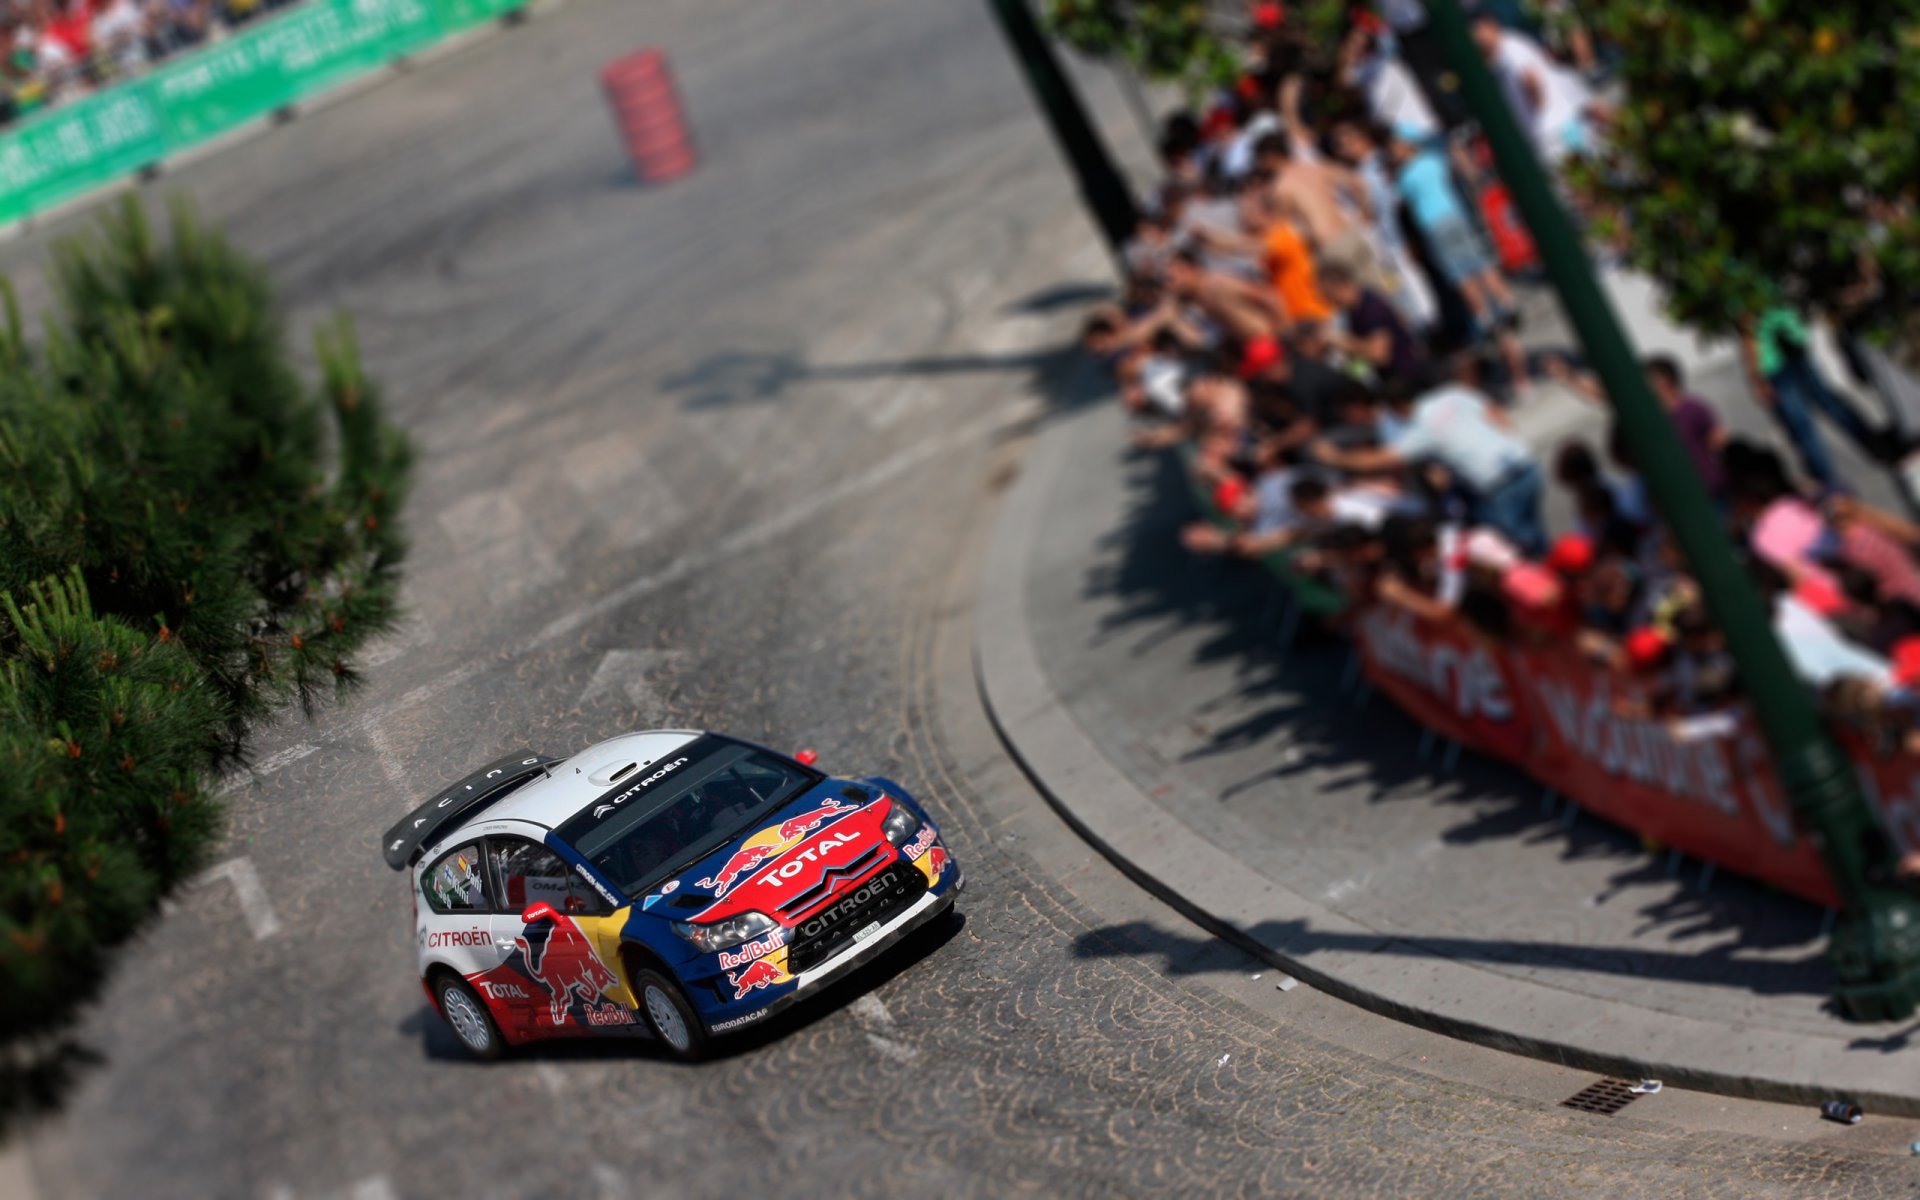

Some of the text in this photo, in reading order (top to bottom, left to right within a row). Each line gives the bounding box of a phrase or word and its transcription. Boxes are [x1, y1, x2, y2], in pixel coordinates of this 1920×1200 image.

[614, 757, 688, 804] CITROËN
[757, 831, 861, 887] TOTAL
[466, 864, 482, 893] Dani
[526, 907, 549, 919] TOTAL
[804, 872, 897, 938] CITROËN
[429, 926, 492, 947] CITROËN
[480, 981, 530, 999] TOTAL
